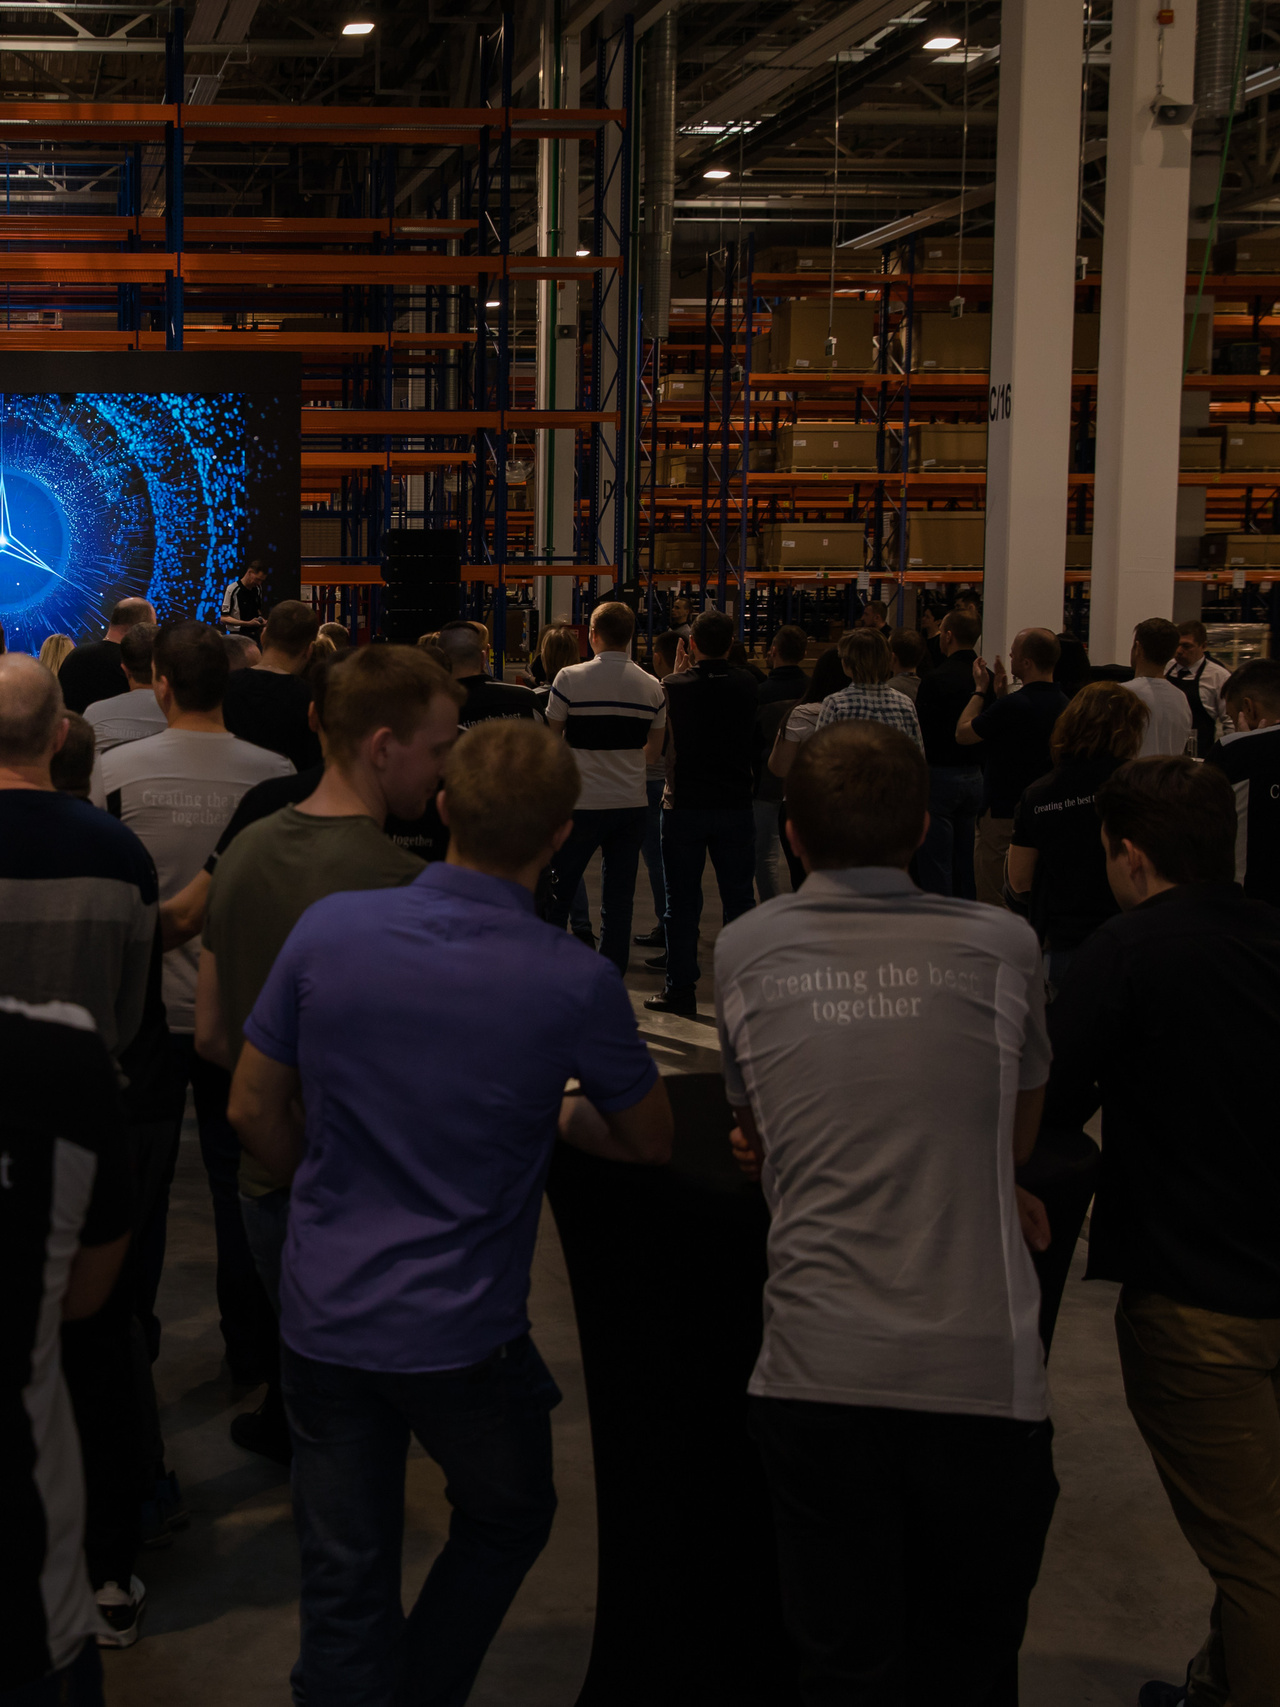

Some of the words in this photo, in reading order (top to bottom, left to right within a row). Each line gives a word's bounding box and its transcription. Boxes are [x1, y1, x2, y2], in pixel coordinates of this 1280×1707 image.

[990, 383, 1011, 421] C/16
[142, 790, 202, 808] Creating
[207, 792, 230, 808] the
[1033, 801, 1064, 815] Creating
[1064, 797, 1076, 808] the
[1076, 794, 1092, 806] best
[761, 966, 868, 1001] Creating
[878, 962, 919, 988] the
[812, 992, 920, 1025] together
